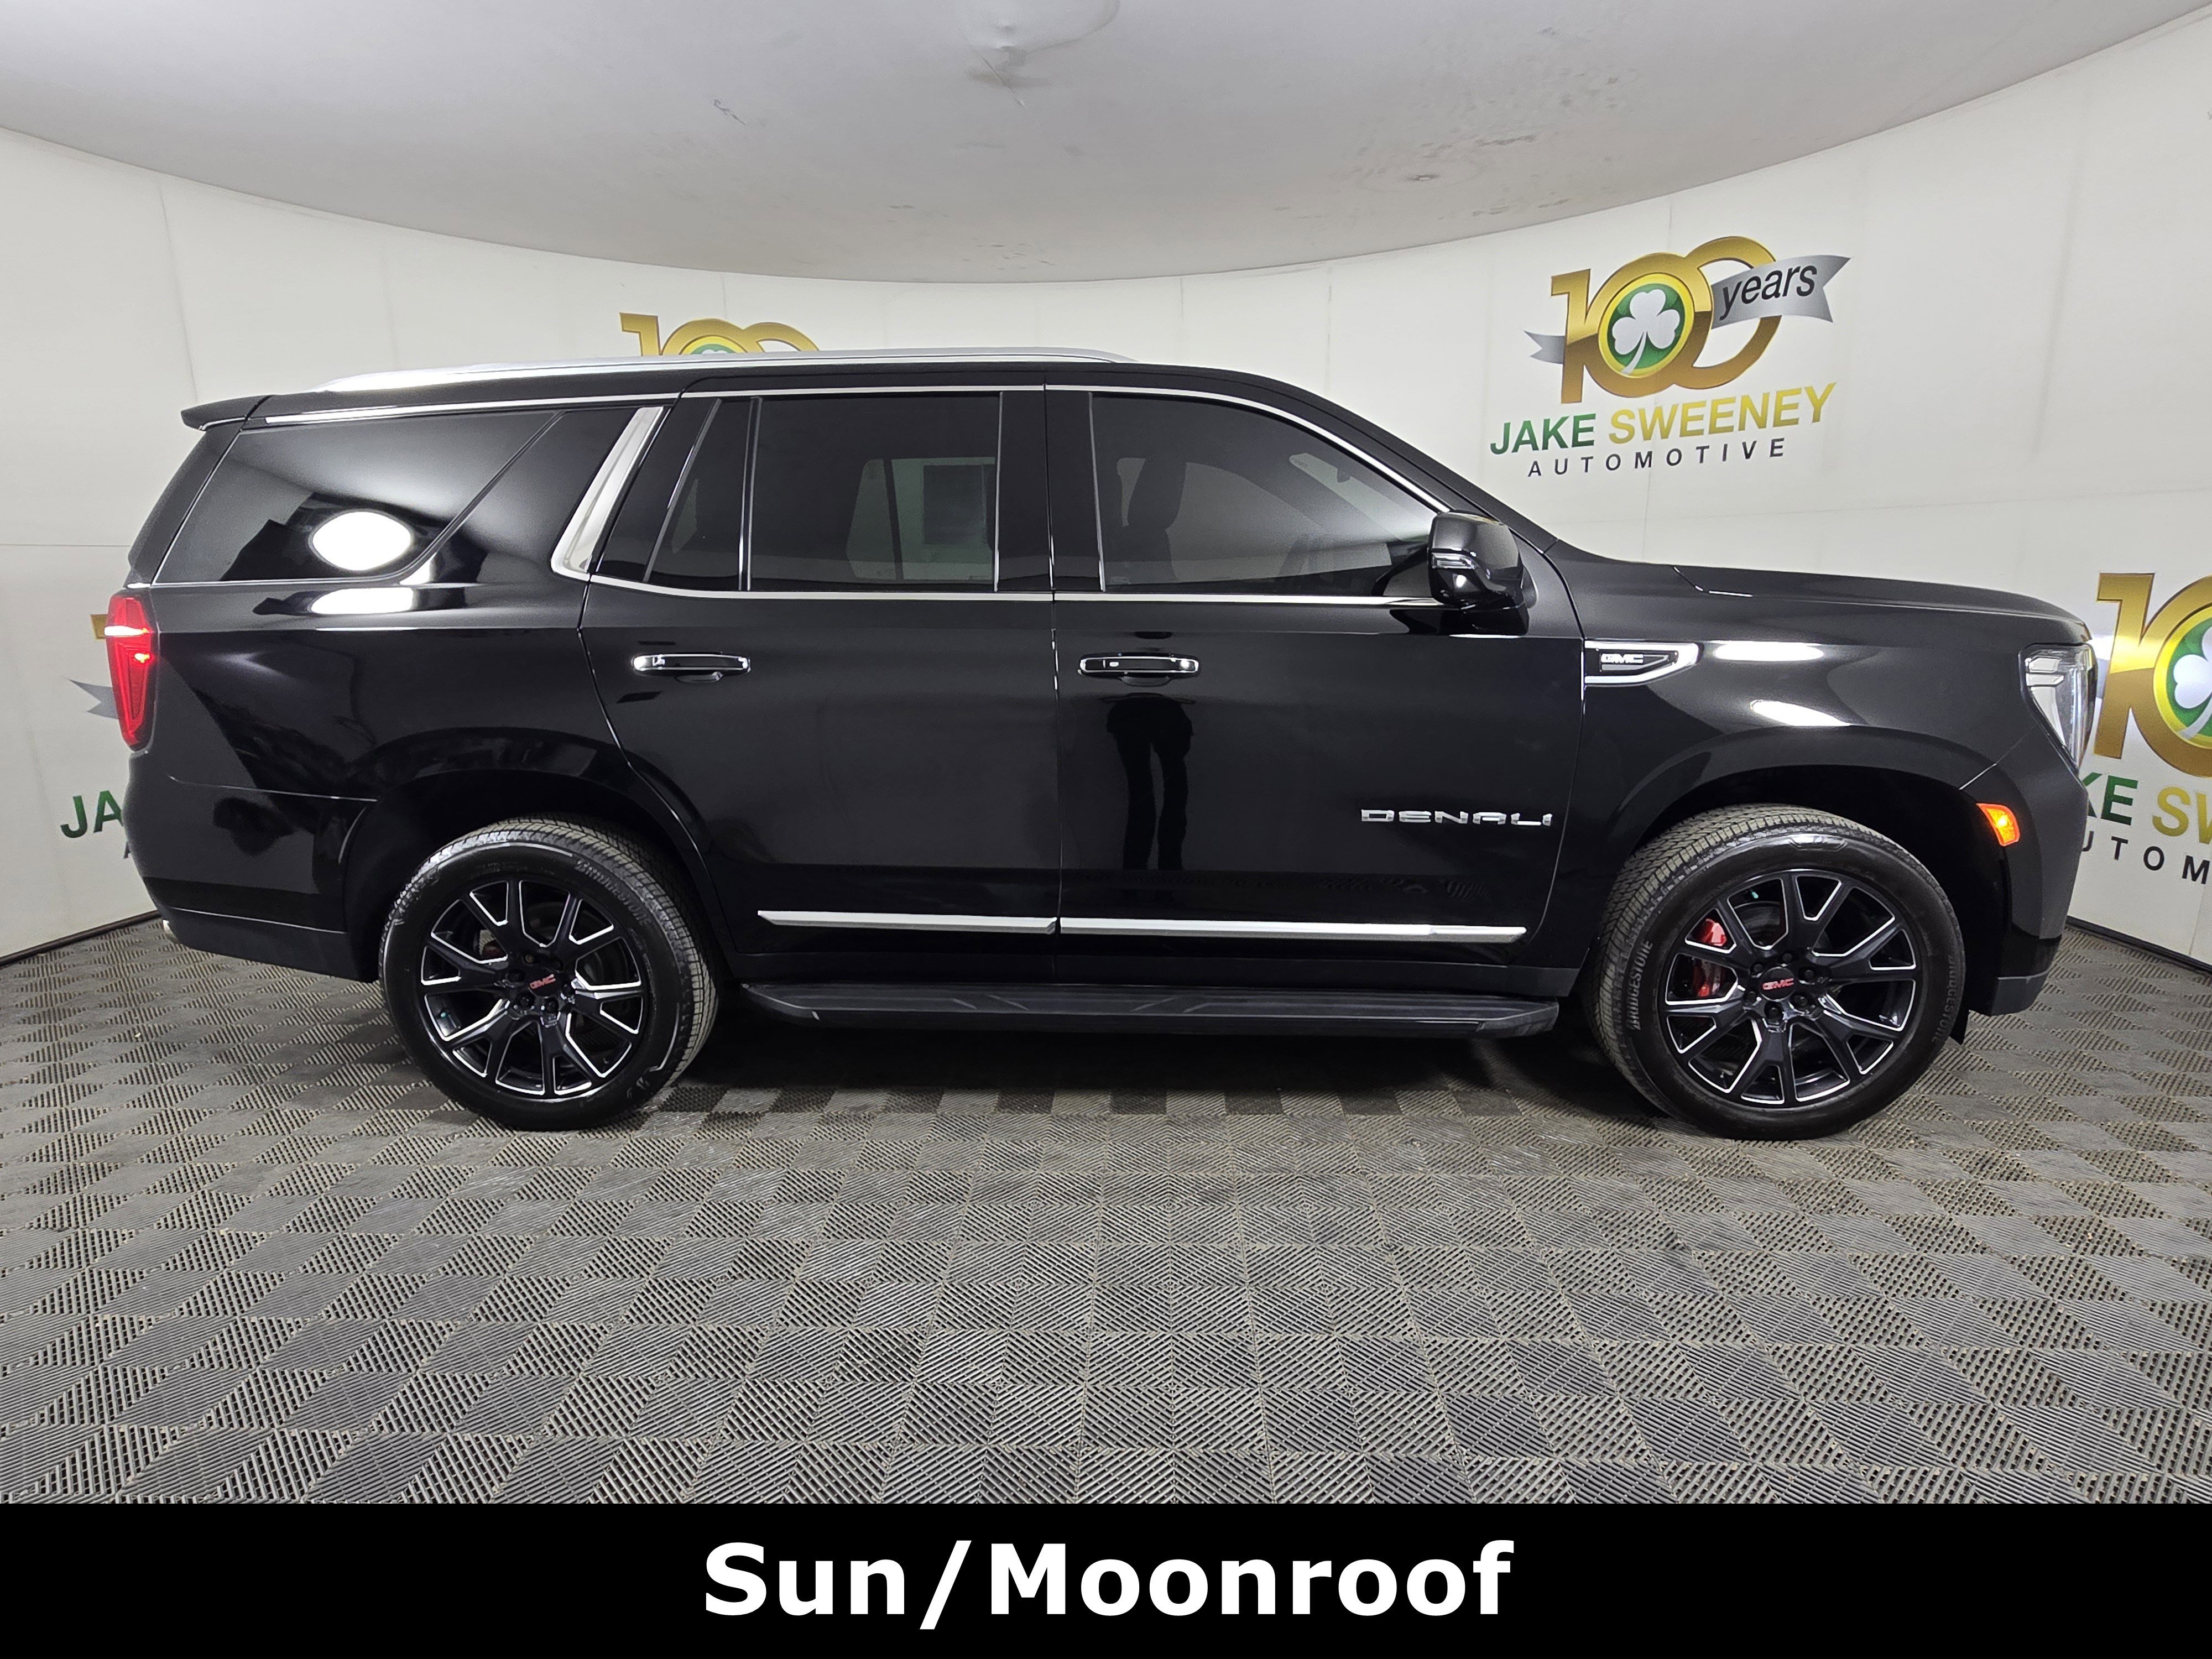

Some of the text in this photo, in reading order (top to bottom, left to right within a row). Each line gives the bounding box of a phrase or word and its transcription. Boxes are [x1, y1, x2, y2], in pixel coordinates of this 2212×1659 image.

[1719, 264, 1818, 321] years
[1490, 382, 1837, 455] JAKE SWEENEY
[1527, 438, 1785, 478] AUTOMOTIVE
[1600, 653, 1644, 664] GMC
[1361, 809, 1552, 826] DENALI
[529, 973, 556, 989] GMC
[1762, 977, 1794, 990] GMC
